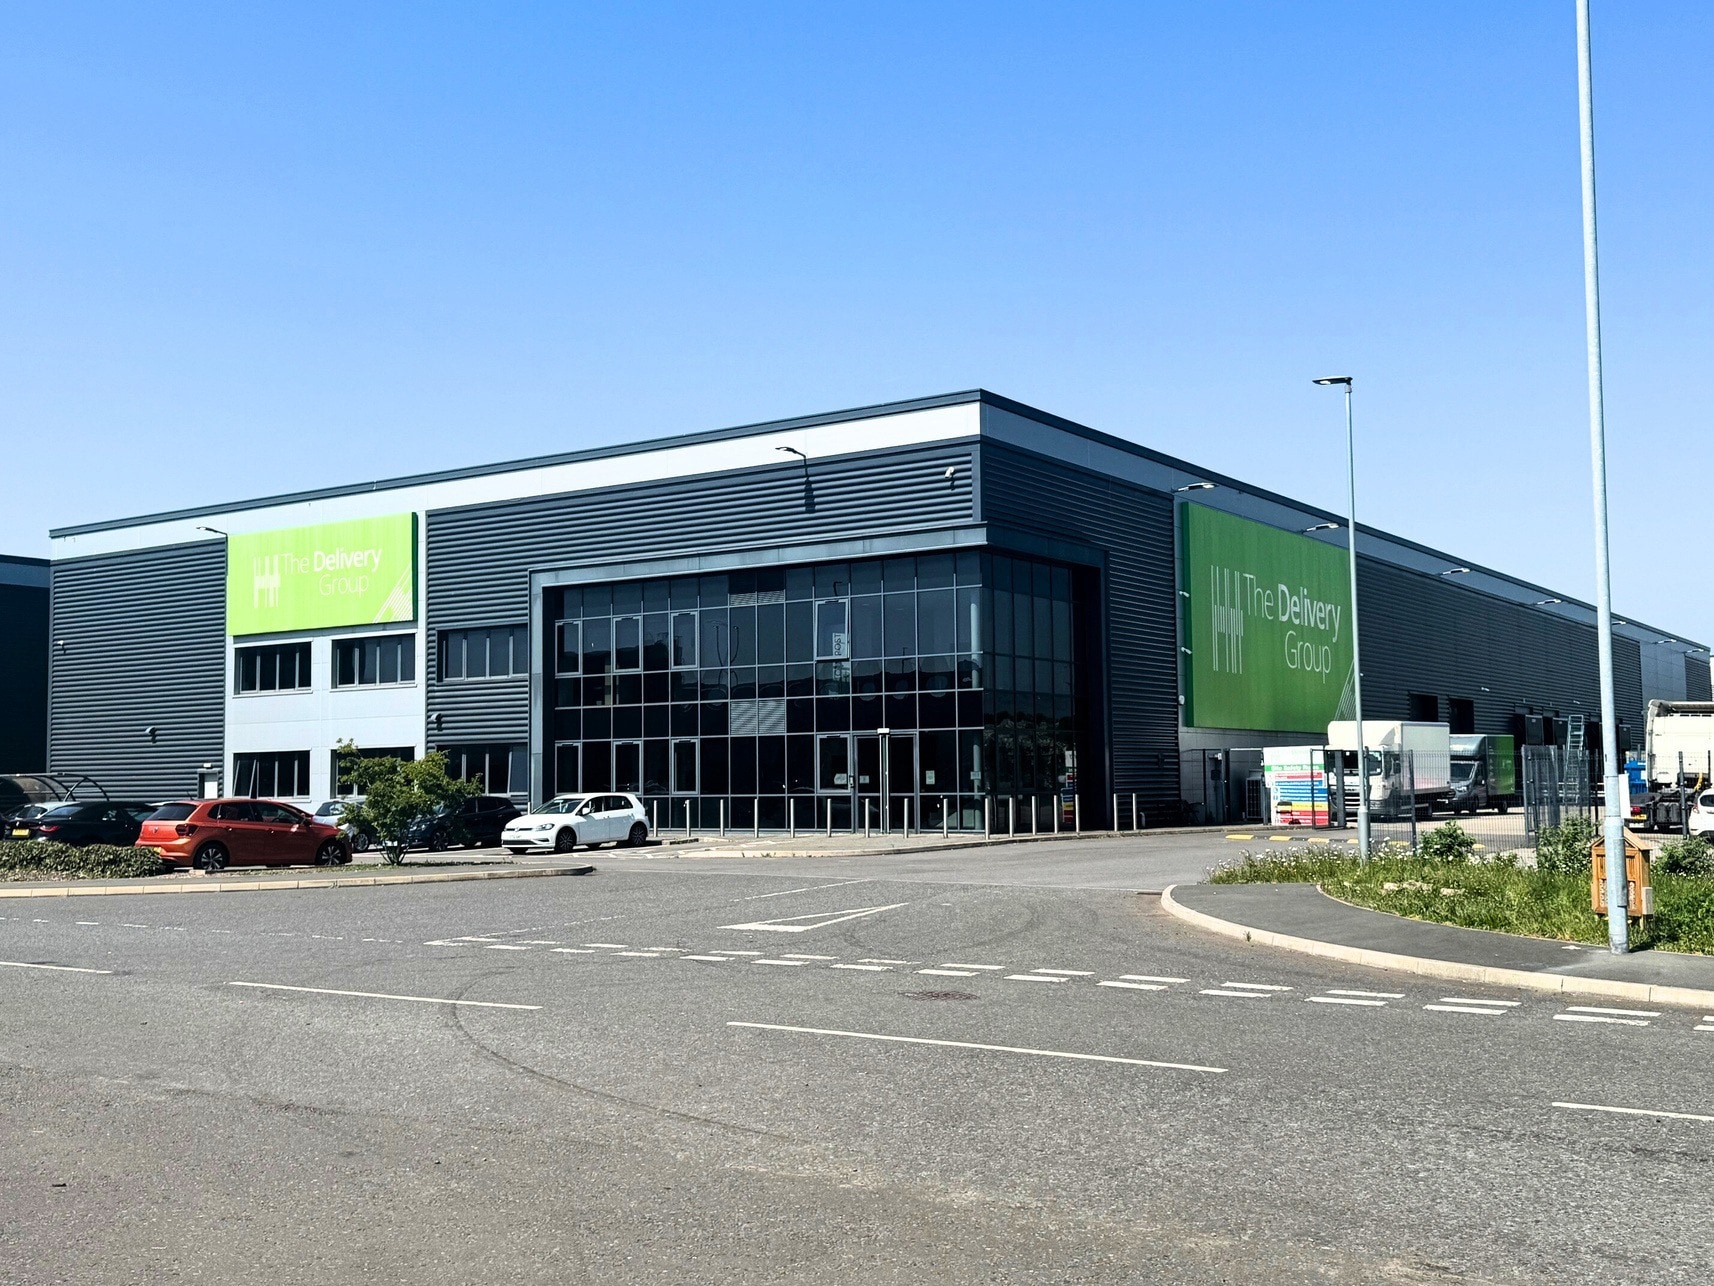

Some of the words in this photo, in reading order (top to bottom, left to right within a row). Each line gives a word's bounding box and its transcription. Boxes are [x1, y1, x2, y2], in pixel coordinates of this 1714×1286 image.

[281, 552, 310, 575] The
[313, 547, 382, 573] Delivery
[319, 573, 369, 598] Group
[1243, 573, 1274, 619] The
[1278, 583, 1340, 643] Delivery
[1285, 630, 1331, 684] Group
